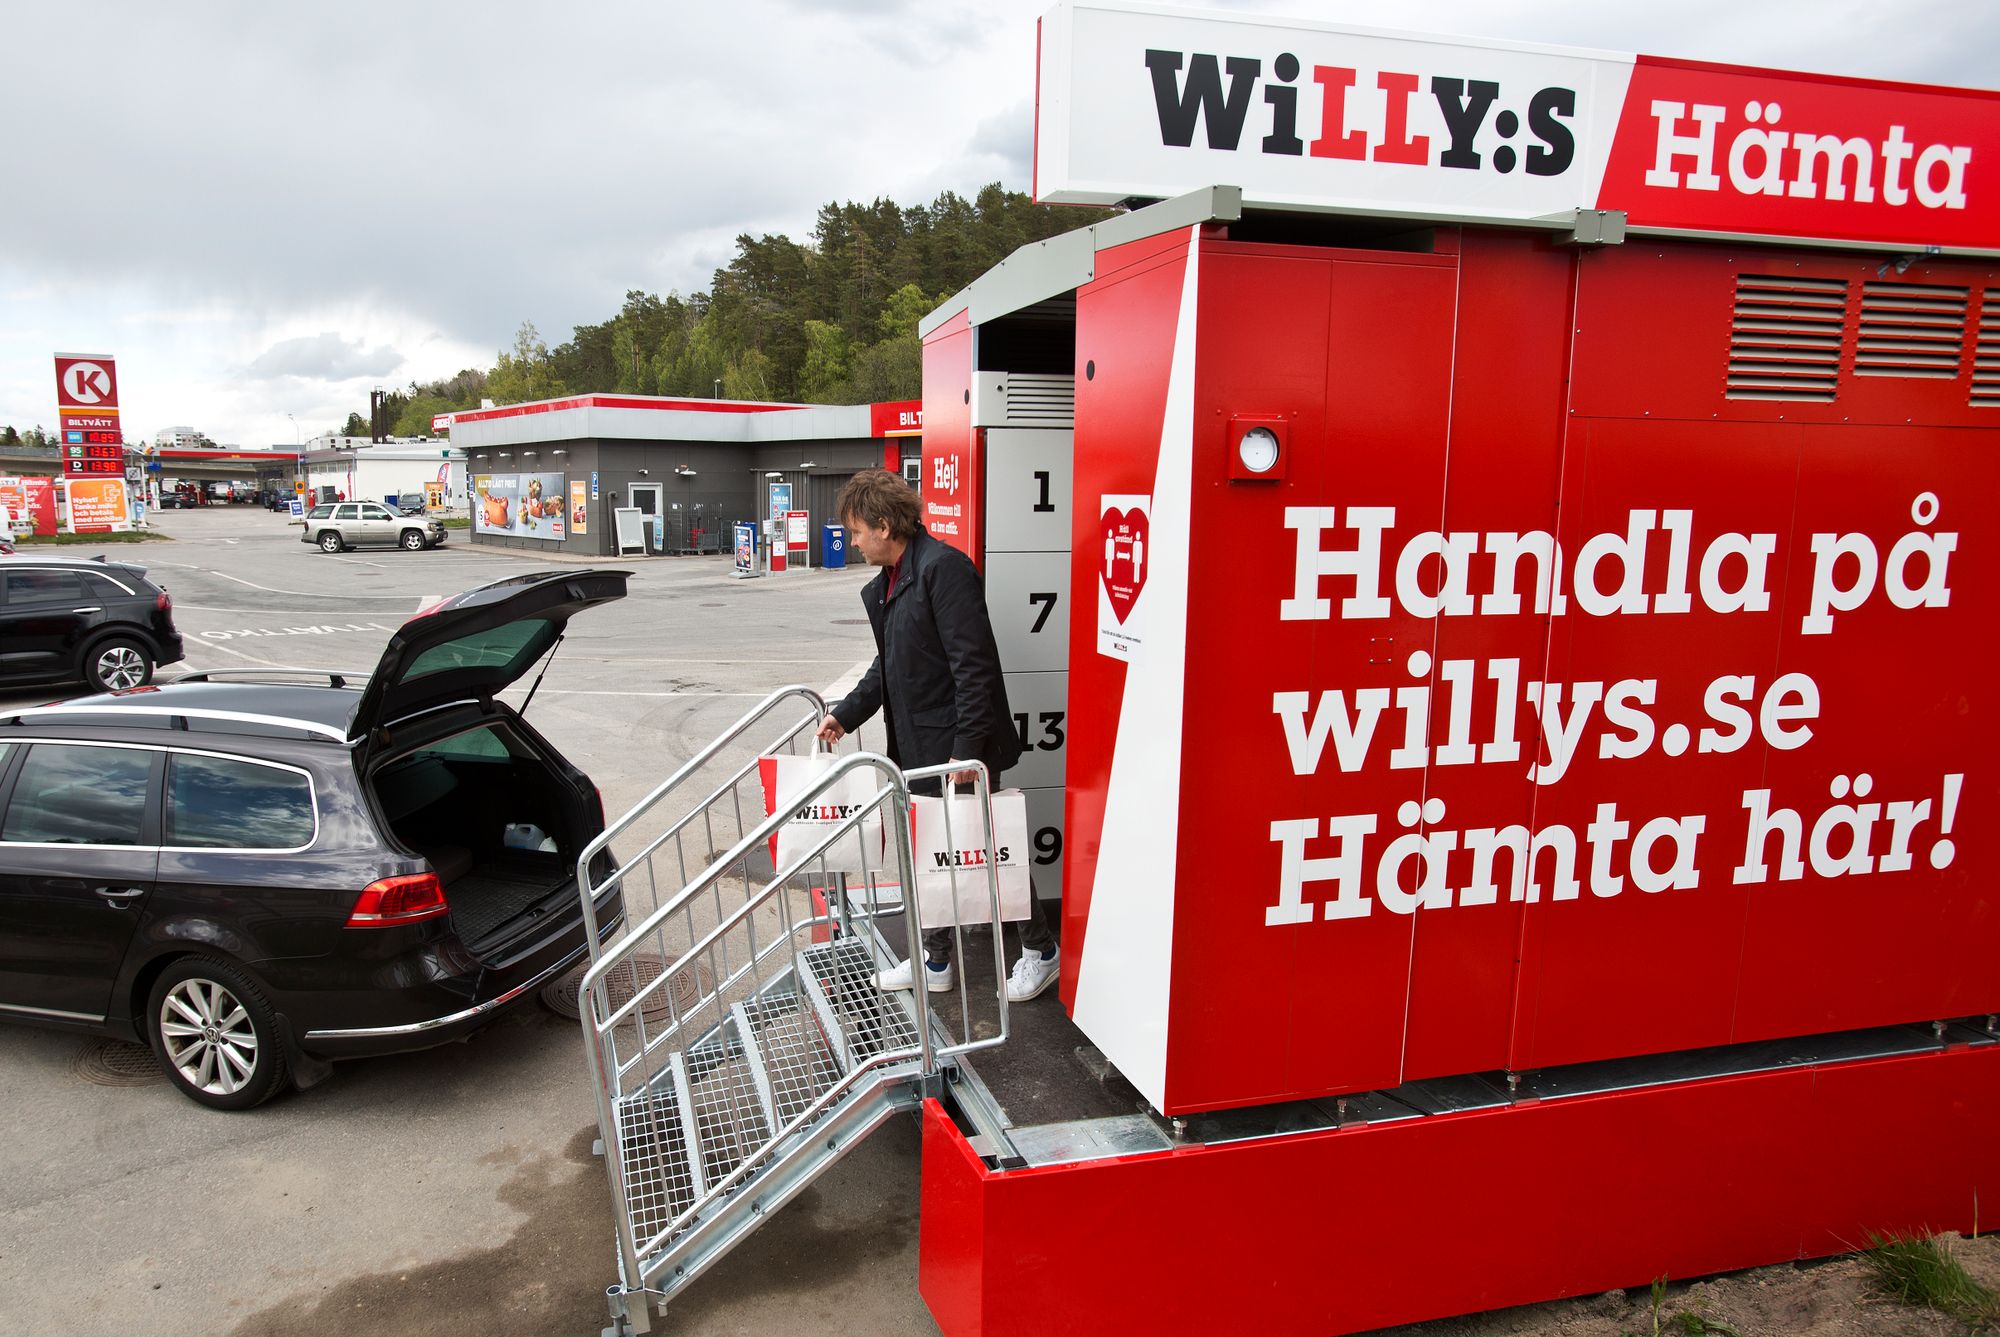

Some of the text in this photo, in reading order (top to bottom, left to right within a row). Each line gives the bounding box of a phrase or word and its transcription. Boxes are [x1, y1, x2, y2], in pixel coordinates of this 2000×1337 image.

[1146, 50, 1971, 209] WiLLY:S Hämta
[68, 418, 112, 426] BILTVÄTT
[934, 453, 959, 495] Hej!
[1033, 471, 1055, 512] 1
[928, 502, 953, 516] Välkommen
[937, 521, 945, 533] bra
[1280, 492, 1958, 634] Handla på
[1029, 592, 1058, 633] 7
[1013, 711, 1066, 752] 13
[1273, 651, 1819, 785] willys.se
[934, 846, 1010, 867] WiLL:S
[1028, 826, 1063, 866] 9
[1265, 773, 1963, 926] Hämta här!
